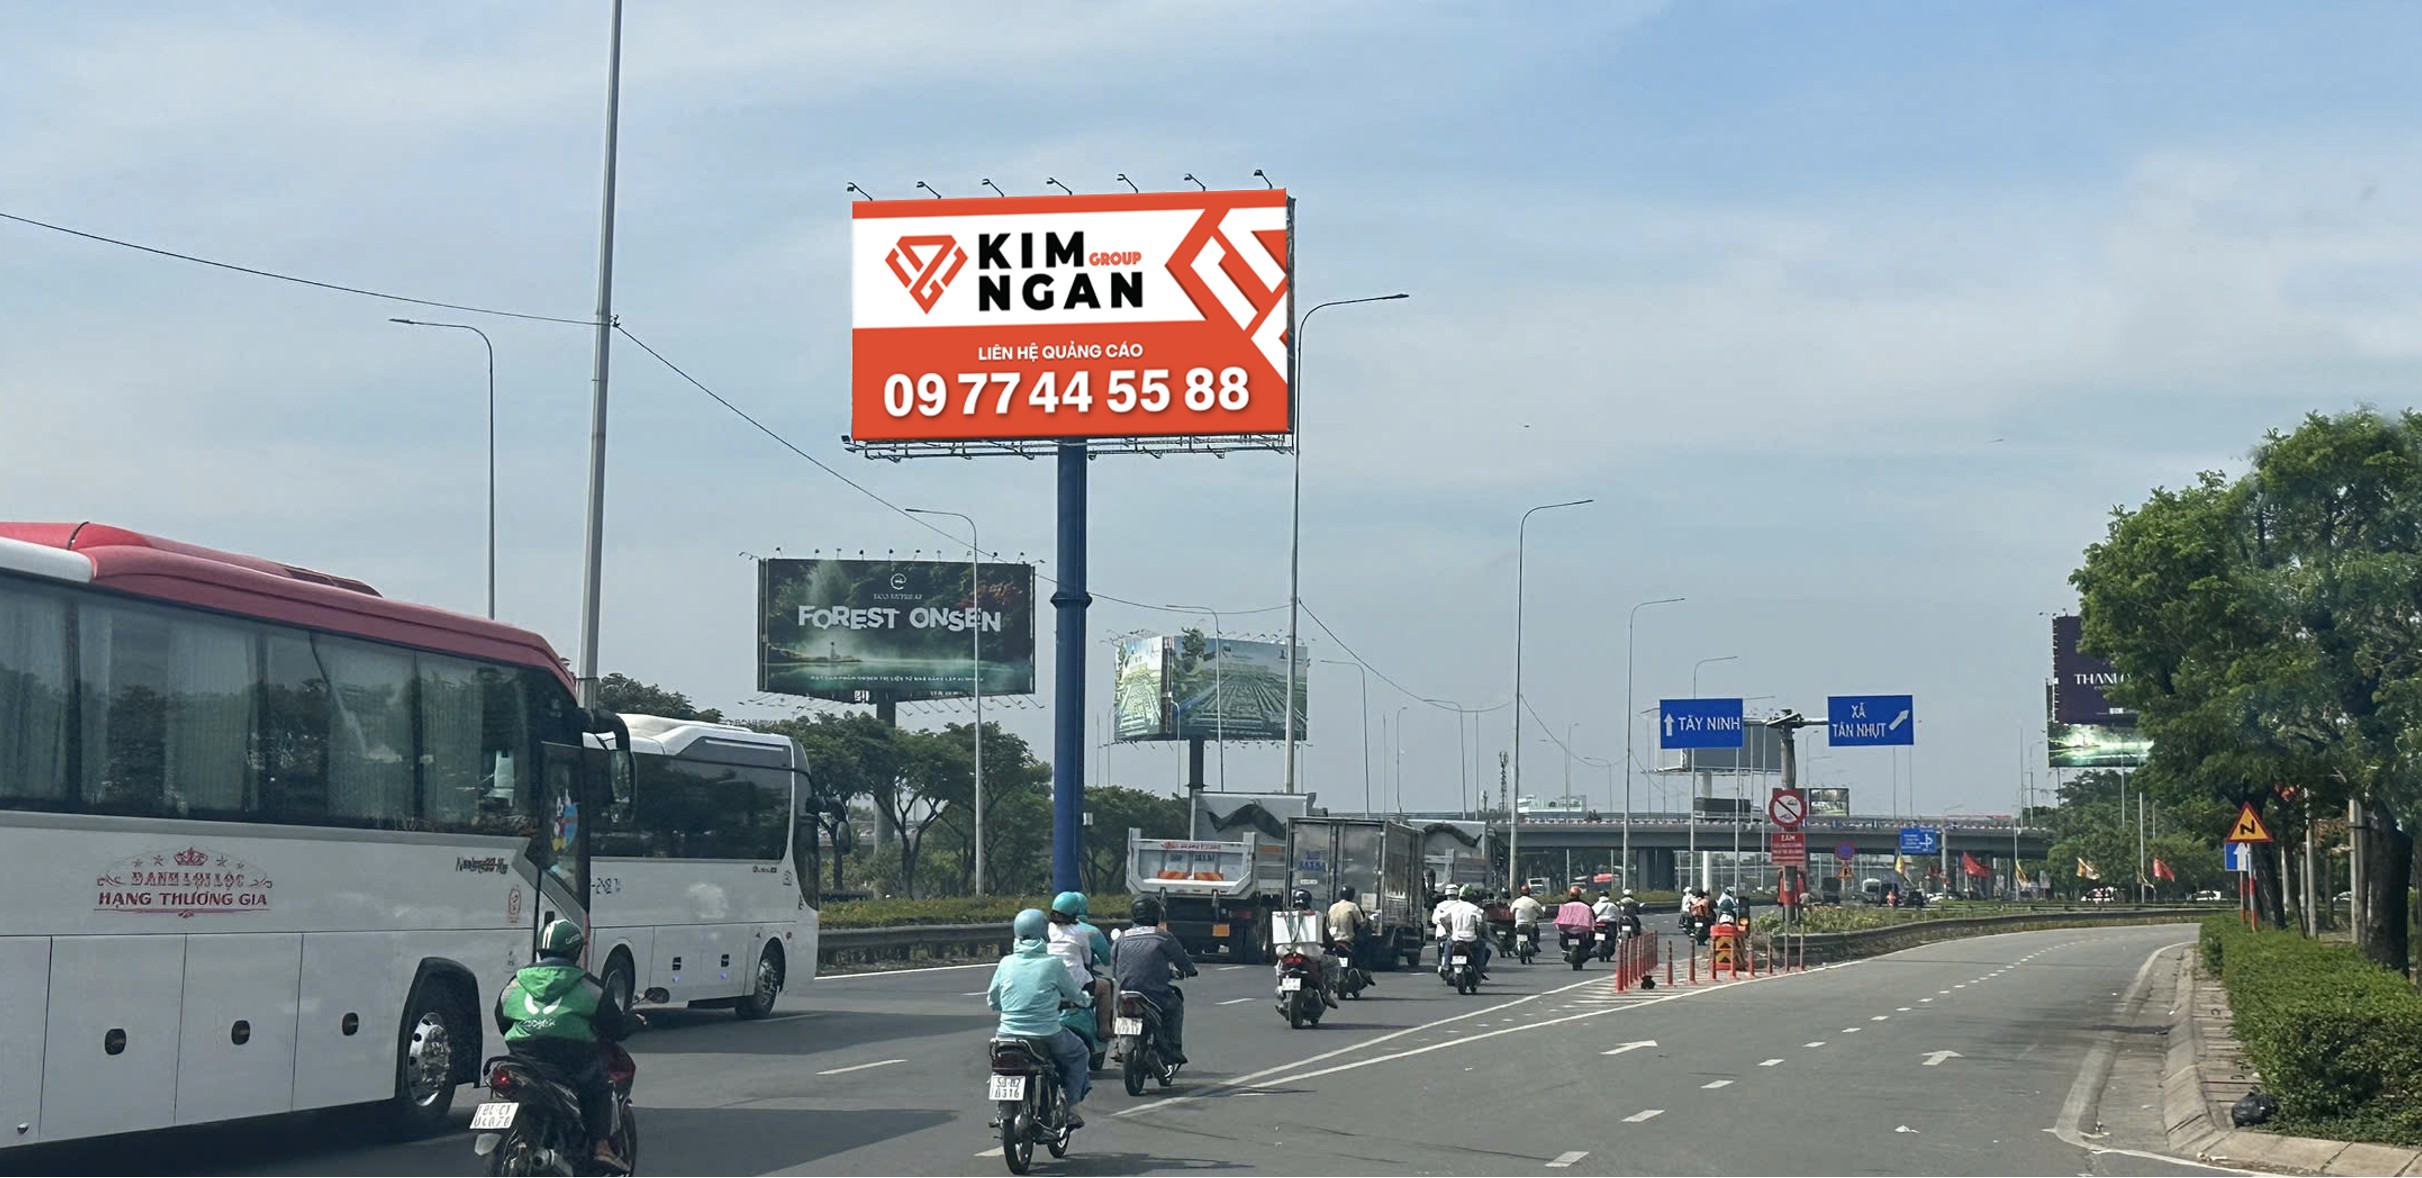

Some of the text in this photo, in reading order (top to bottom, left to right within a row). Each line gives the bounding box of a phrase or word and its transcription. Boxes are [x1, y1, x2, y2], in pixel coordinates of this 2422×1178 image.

[978, 231, 1084, 270] KIM
[1089, 251, 1142, 267] GROUP
[978, 271, 1143, 312] NGAN
[978, 340, 1144, 363] LIÊN HỆ QUẢNG CÁO
[883, 366, 1250, 417] 09 77 44 55 88
[798, 605, 1001, 632] FOREST ONSEN
[1851, 702, 1866, 719] XÃ
[1707, 717, 1741, 730] NINH
[98, 890, 268, 908] HẠNG THƯƠNG GIA
